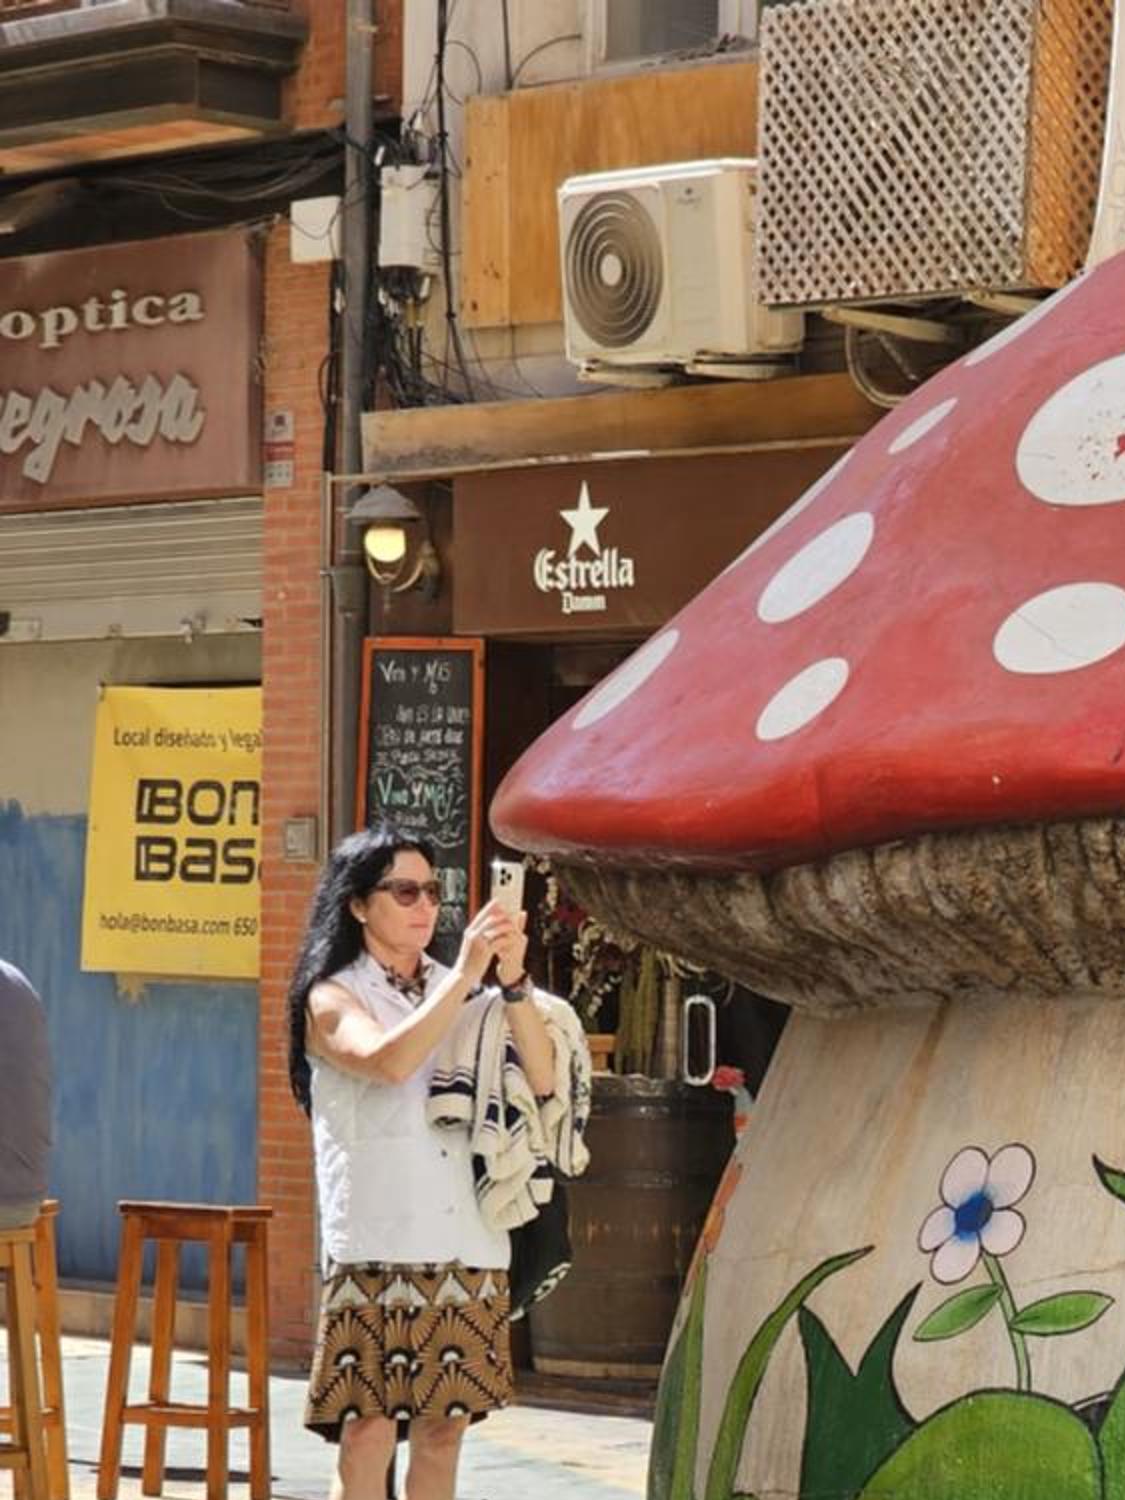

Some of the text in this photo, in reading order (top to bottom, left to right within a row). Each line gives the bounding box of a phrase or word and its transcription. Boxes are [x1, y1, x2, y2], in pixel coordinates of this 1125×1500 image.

[0, 288, 206, 349] optica
[533, 547, 635, 592] Estrella
[113, 726, 151, 747] Local
[134, 836, 262, 884] Bas
